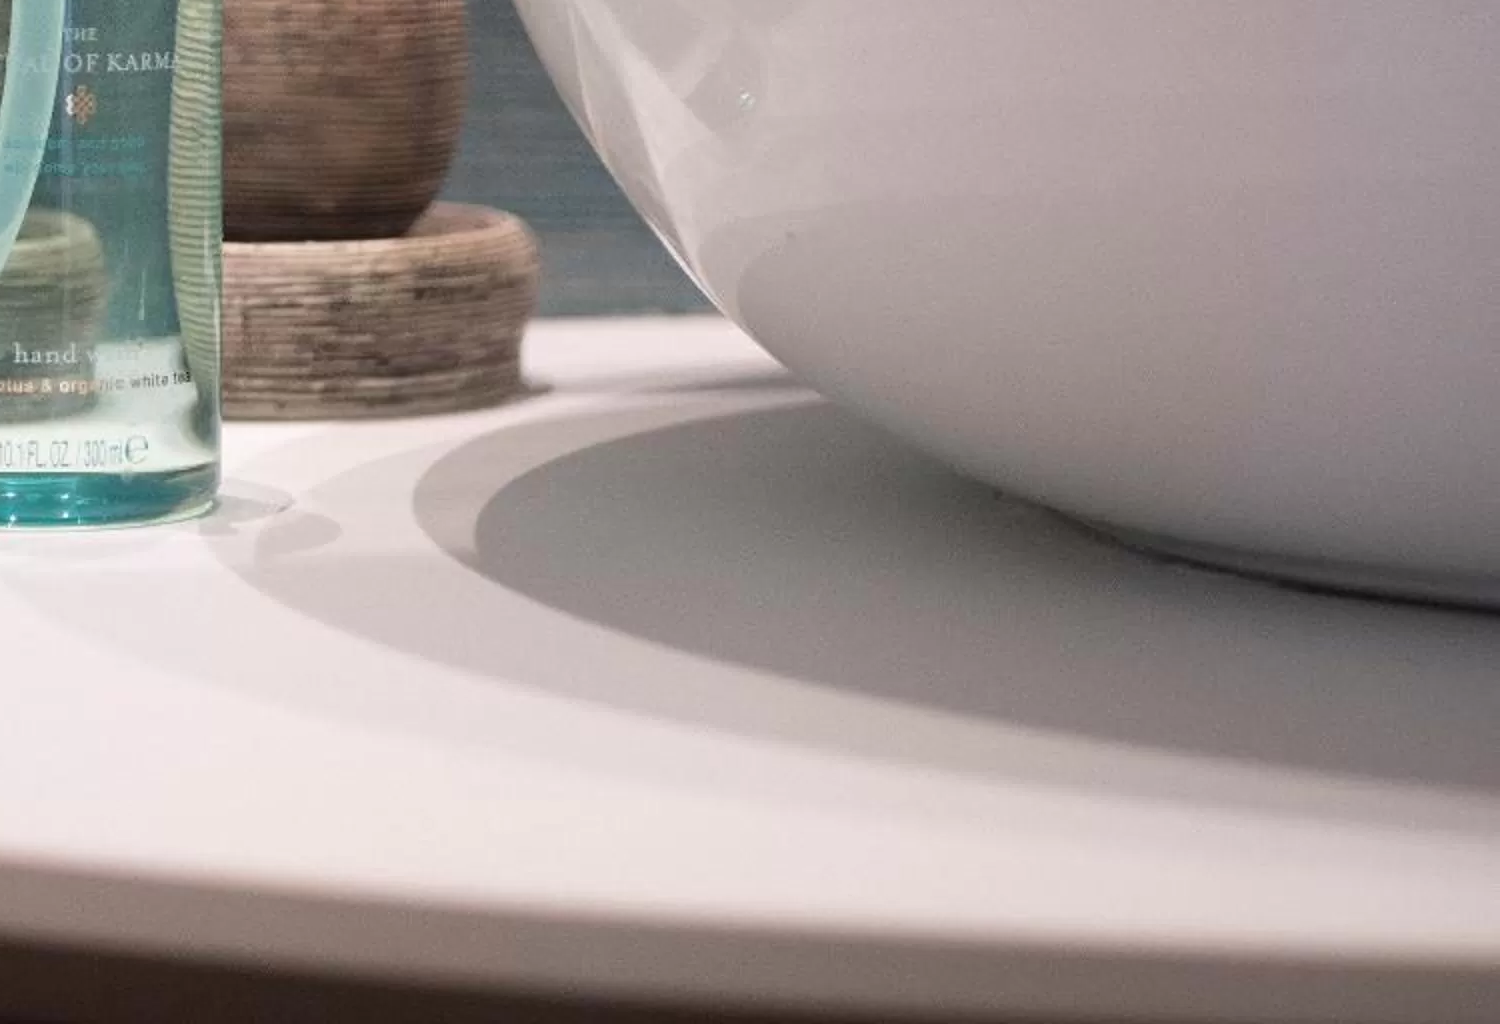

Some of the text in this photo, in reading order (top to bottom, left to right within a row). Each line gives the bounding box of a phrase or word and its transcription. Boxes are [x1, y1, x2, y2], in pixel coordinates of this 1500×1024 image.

[63, 27, 99, 41] THE
[63, 53, 100, 73] OF
[12, 341, 78, 364] hand
[59, 377, 125, 396] orgnic
